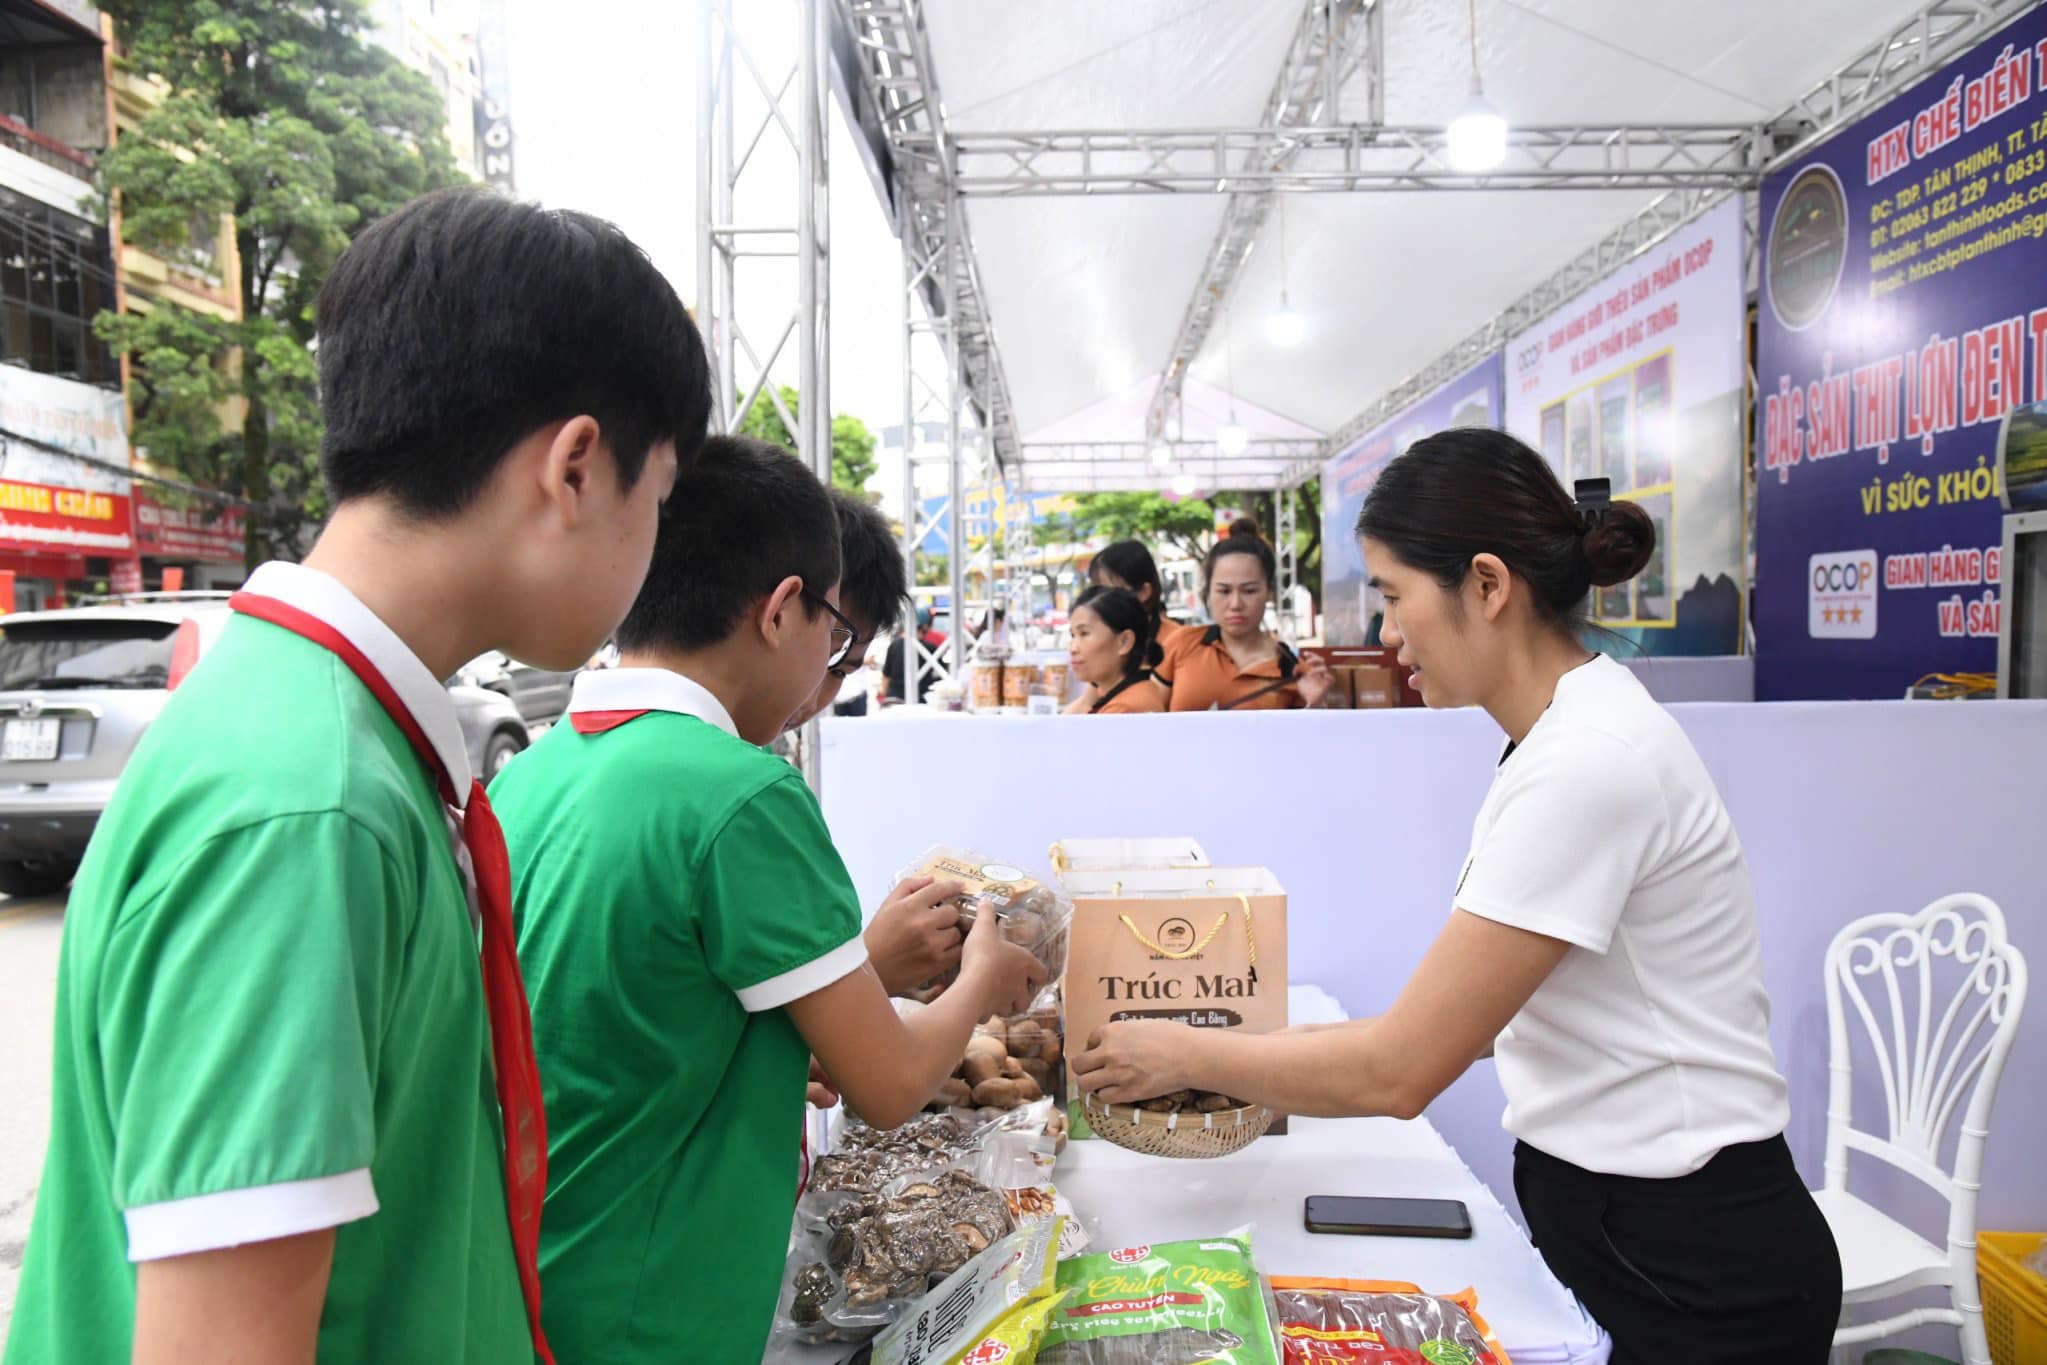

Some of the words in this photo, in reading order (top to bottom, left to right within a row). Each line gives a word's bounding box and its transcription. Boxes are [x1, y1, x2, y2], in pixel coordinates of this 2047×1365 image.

[1868, 121, 1910, 185] HTX
[1913, 76, 1963, 159] CHẾ
[1965, 43, 2031, 132] BIẾN
[1960, 177, 1988, 207] 229
[2005, 150, 2045, 184] 0833
[1765, 375, 1803, 483] ĐẶC
[1806, 351, 1849, 461] SẢN
[1853, 355, 1902, 464] THỊT
[1905, 334, 1957, 455] LỢN
[1961, 316, 2024, 426] ĐEN
[1862, 477, 1882, 515] VÌ
[1886, 472, 1930, 512] SỨC
[1813, 561, 1872, 592] OCOP
[1885, 553, 1927, 589] GIAN
[1928, 544, 1982, 587] HÀNG
[1938, 595, 1965, 637] VÀ
[1098, 972, 1182, 1000] Trúc
[1194, 973, 1256, 999] Mai
[1172, 1265, 1250, 1289] Ngây
[1084, 1316, 1119, 1329] rice
[1091, 1301, 1123, 1313] CAO
